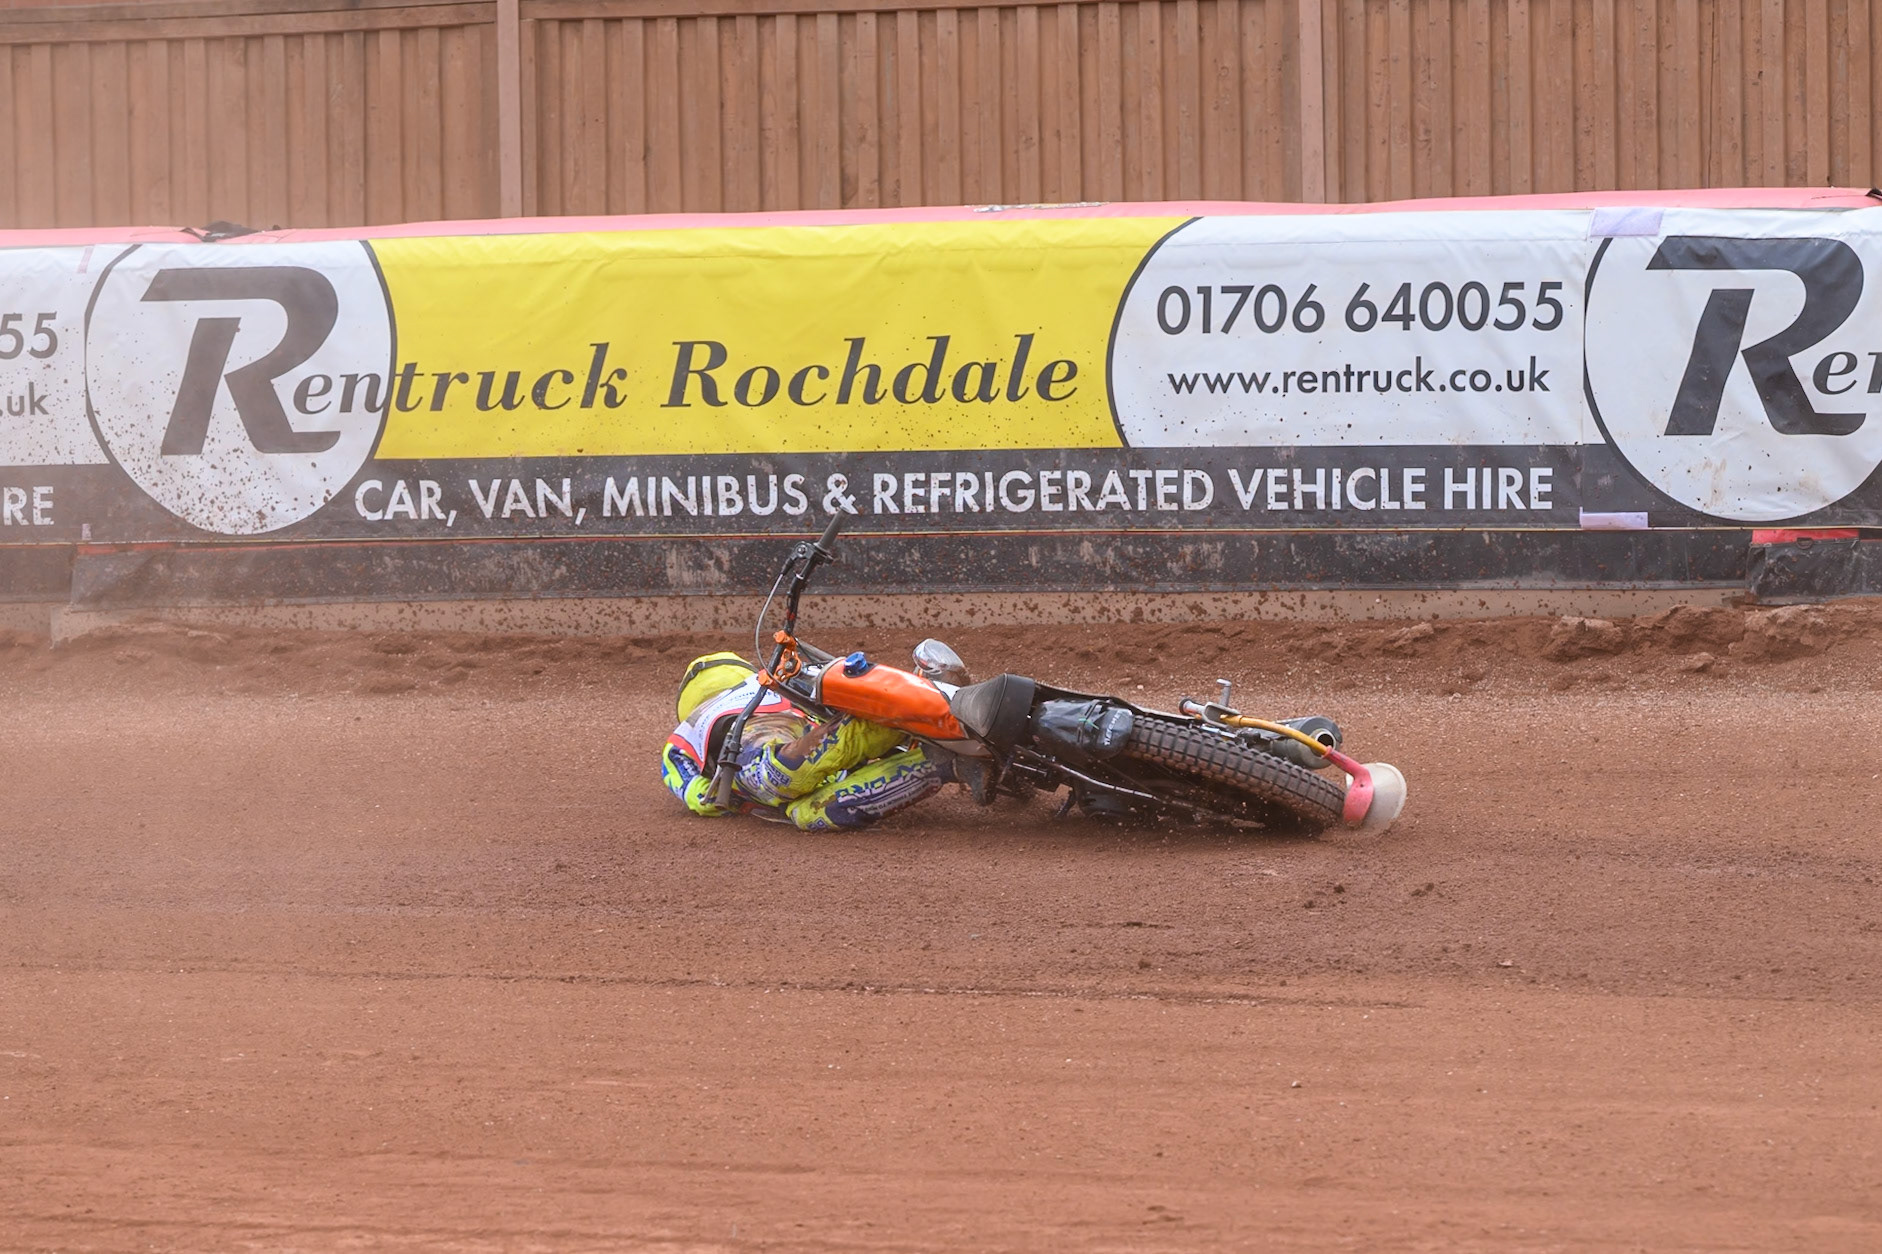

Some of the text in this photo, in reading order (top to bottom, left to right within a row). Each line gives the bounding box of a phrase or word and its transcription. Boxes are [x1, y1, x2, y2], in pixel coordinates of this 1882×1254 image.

[1156, 280, 1564, 335] 01706 640055
[140, 265, 1079, 456] Rentruck Rochdale
[1167, 355, 1551, 396] www.rentruck.co.uk
[3, 486, 55, 526] RE
[354, 465, 1554, 528] CAR, VAN, MINIBUS & REFRIGERATED VEHICLE HIRE
